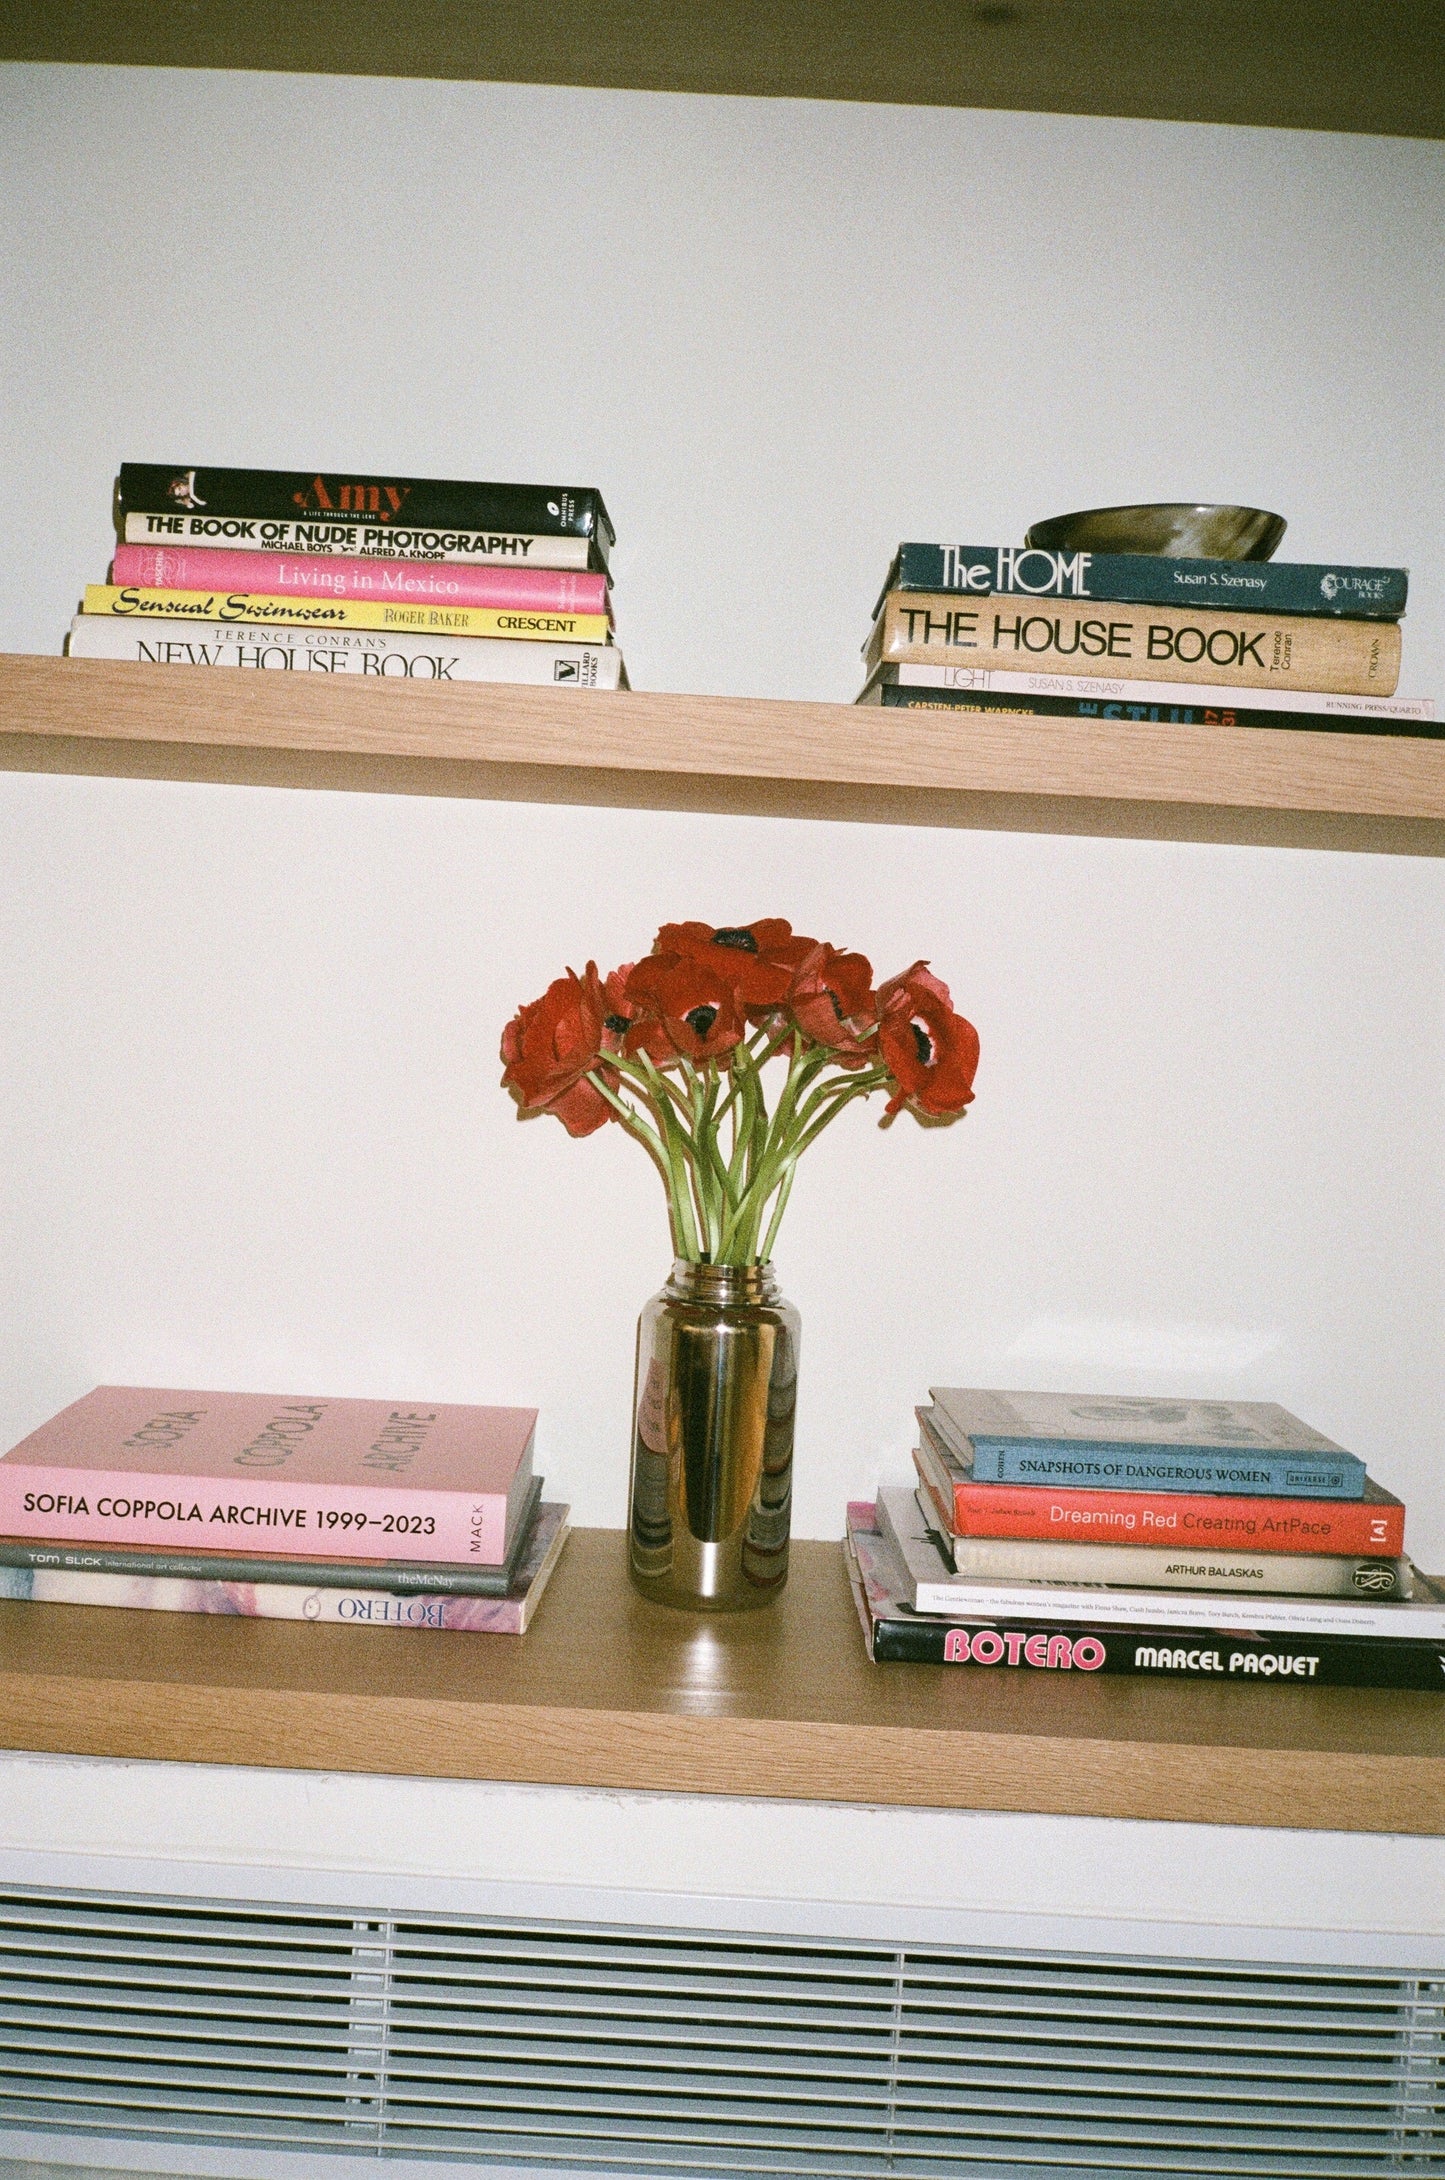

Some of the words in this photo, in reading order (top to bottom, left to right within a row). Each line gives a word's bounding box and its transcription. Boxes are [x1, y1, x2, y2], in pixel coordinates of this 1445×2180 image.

[293, 475, 411, 522] Amy
[560, 493, 568, 528] OMNIBUS
[146, 515, 184, 534] THE
[190, 519, 257, 540] BOOK
[259, 522, 290, 541] OF
[295, 524, 357, 546] NUDE
[364, 528, 534, 557] PHOTOGRAPHY
[261, 540, 305, 552] MICHAEL
[306, 542, 333, 553] BOYS
[359, 547, 396, 557] ALFRED
[398, 549, 409, 558] A.
[410, 550, 446, 560] KNOPF
[278, 564, 346, 594] Living
[353, 570, 373, 590] in
[382, 571, 459, 594] Mexico
[940, 545, 991, 590] The
[997, 547, 1092, 596] HOME
[1173, 571, 1207, 586] Susan
[1209, 572, 1219, 585] S.
[1220, 573, 1268, 591] Szenasy
[1320, 573, 1389, 595] COURAGE
[112, 587, 214, 614] Sensual
[218, 594, 349, 621] Swimwear
[383, 608, 425, 626] ROGER
[429, 610, 470, 628] BAKER
[214, 629, 295, 643] TERENCE
[305, 633, 387, 649] CONRAN'S
[497, 616, 577, 633] CRESCENT
[900, 607, 979, 648] THE
[992, 614, 1134, 659] HOUSE
[1147, 624, 1267, 668] BOOK
[137, 640, 224, 666] NEW
[236, 645, 350, 673] HOUSE
[361, 652, 460, 680] BOOK
[1269, 630, 1283, 672] Terence
[1280, 633, 1292, 671] Conran
[1368, 638, 1380, 679] CROWN
[589, 656, 598, 687] BOOKS
[944, 667, 996, 689] LIGHT
[1027, 677, 1064, 691] SUSAN
[1077, 680, 1124, 695] SZENASY
[1325, 701, 1363, 713] RUNNING
[1364, 703, 1422, 716] PRESS/QUARTO
[122, 1410, 208, 1449] SOFIA
[232, 1404, 328, 1467] COPPOLA
[359, 1411, 437, 1473] ARCHIVE
[1019, 1459, 1101, 1477] SNAPSHOTS
[1103, 1463, 1123, 1477] OF
[1126, 1465, 1212, 1480] DANGEROUS
[1215, 1469, 1272, 1484] WOMEN
[1289, 1475, 1326, 1485] UNIVERSE
[23, 1493, 90, 1516] SOFIA
[97, 1498, 203, 1522] COPPOLA
[209, 1504, 307, 1529] ARCHIVE
[1050, 1505, 1136, 1529] Dreaming
[1142, 1510, 1178, 1528] Red
[1183, 1512, 1257, 1535] Creating
[1262, 1516, 1332, 1536] ArtPace
[470, 1504, 484, 1553] MACK
[28, 1553, 60, 1565] TOM
[65, 1555, 101, 1567] SLICK
[105, 1560, 154, 1570] international
[156, 1563, 168, 1571] art
[169, 1563, 203, 1573] collector
[1165, 1564, 1207, 1577] ARTHUR
[1208, 1566, 1264, 1579] BALASKAS
[338, 1598, 447, 1628] BOTERO
[944, 1628, 1107, 1672] BOTERO
[1135, 1646, 1224, 1672] MARCEL
[1229, 1652, 1320, 1677] PAQUET
